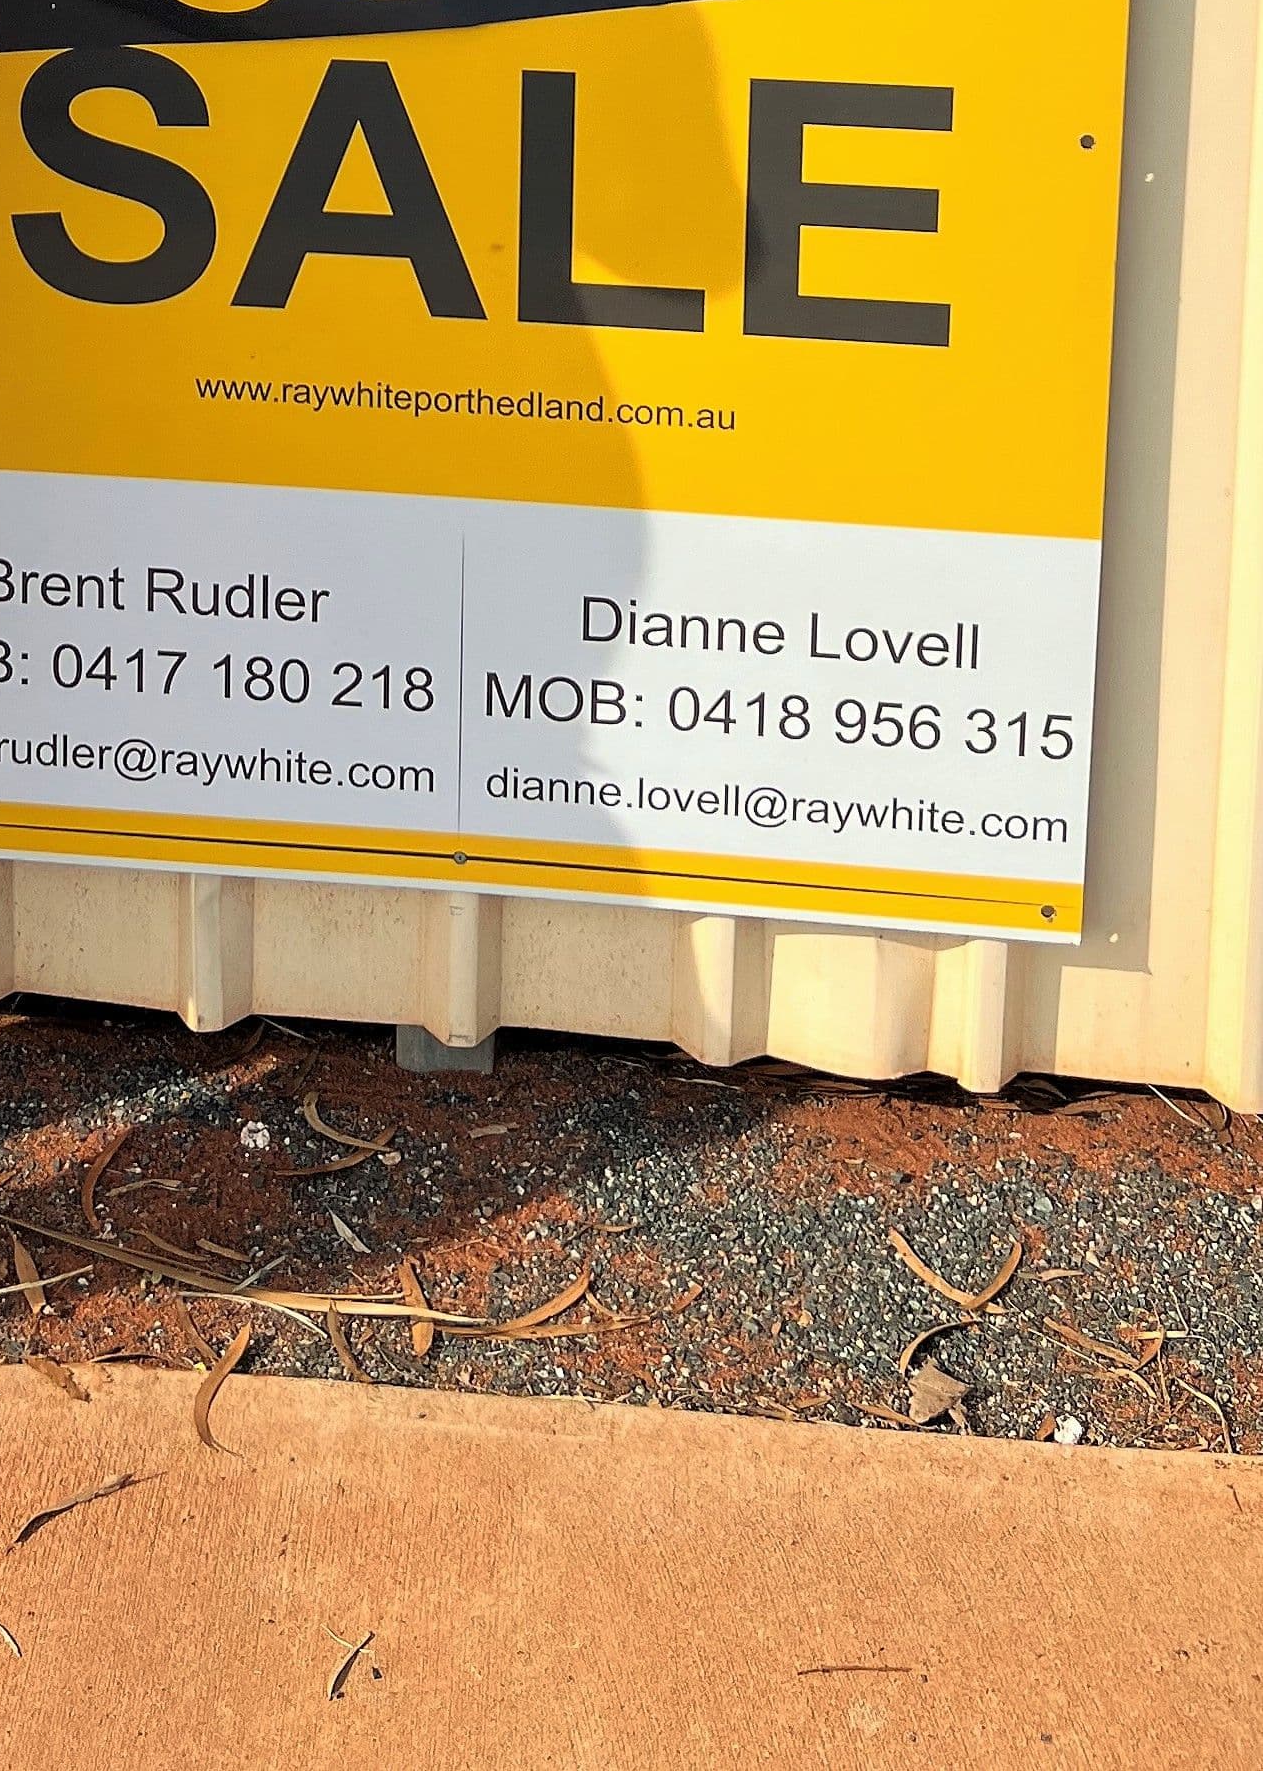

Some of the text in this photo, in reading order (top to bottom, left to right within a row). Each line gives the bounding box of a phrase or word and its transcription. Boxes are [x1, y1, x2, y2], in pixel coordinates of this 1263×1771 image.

[11, 45, 954, 348] SALE
[195, 377, 737, 432] www.raywhiteporthedland.com.au
[147, 566, 331, 623] Rudler
[582, 595, 980, 670] Dianne Lovell
[52, 643, 188, 695] 0417
[212, 653, 311, 704] 180
[331, 661, 435, 713] 218
[485, 671, 1074, 761] MOB: 0418 956 315
[485, 766, 1069, 844] dianne.lovell@raywhite.com
